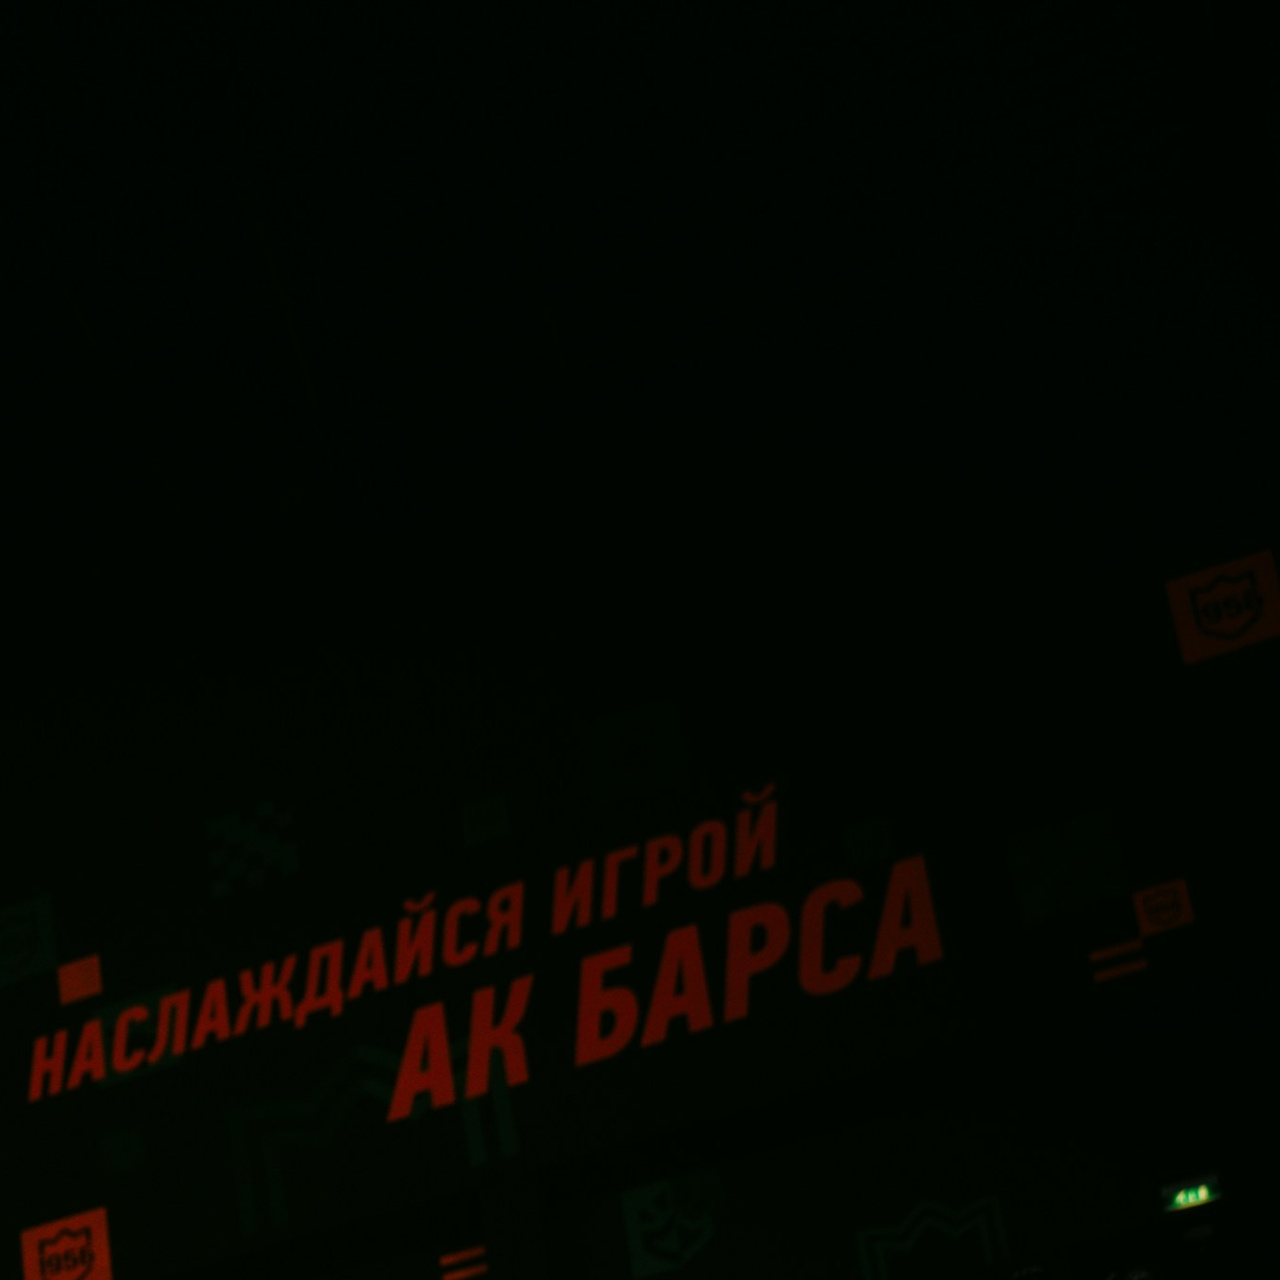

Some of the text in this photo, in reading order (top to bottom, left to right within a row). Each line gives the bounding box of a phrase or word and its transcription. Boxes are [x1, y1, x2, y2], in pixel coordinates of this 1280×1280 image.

[27, 783, 780, 1104] НАСЛАЖДАЙСЯ ИГРОЙ
[386, 852, 946, 1124] АК БАРСА
